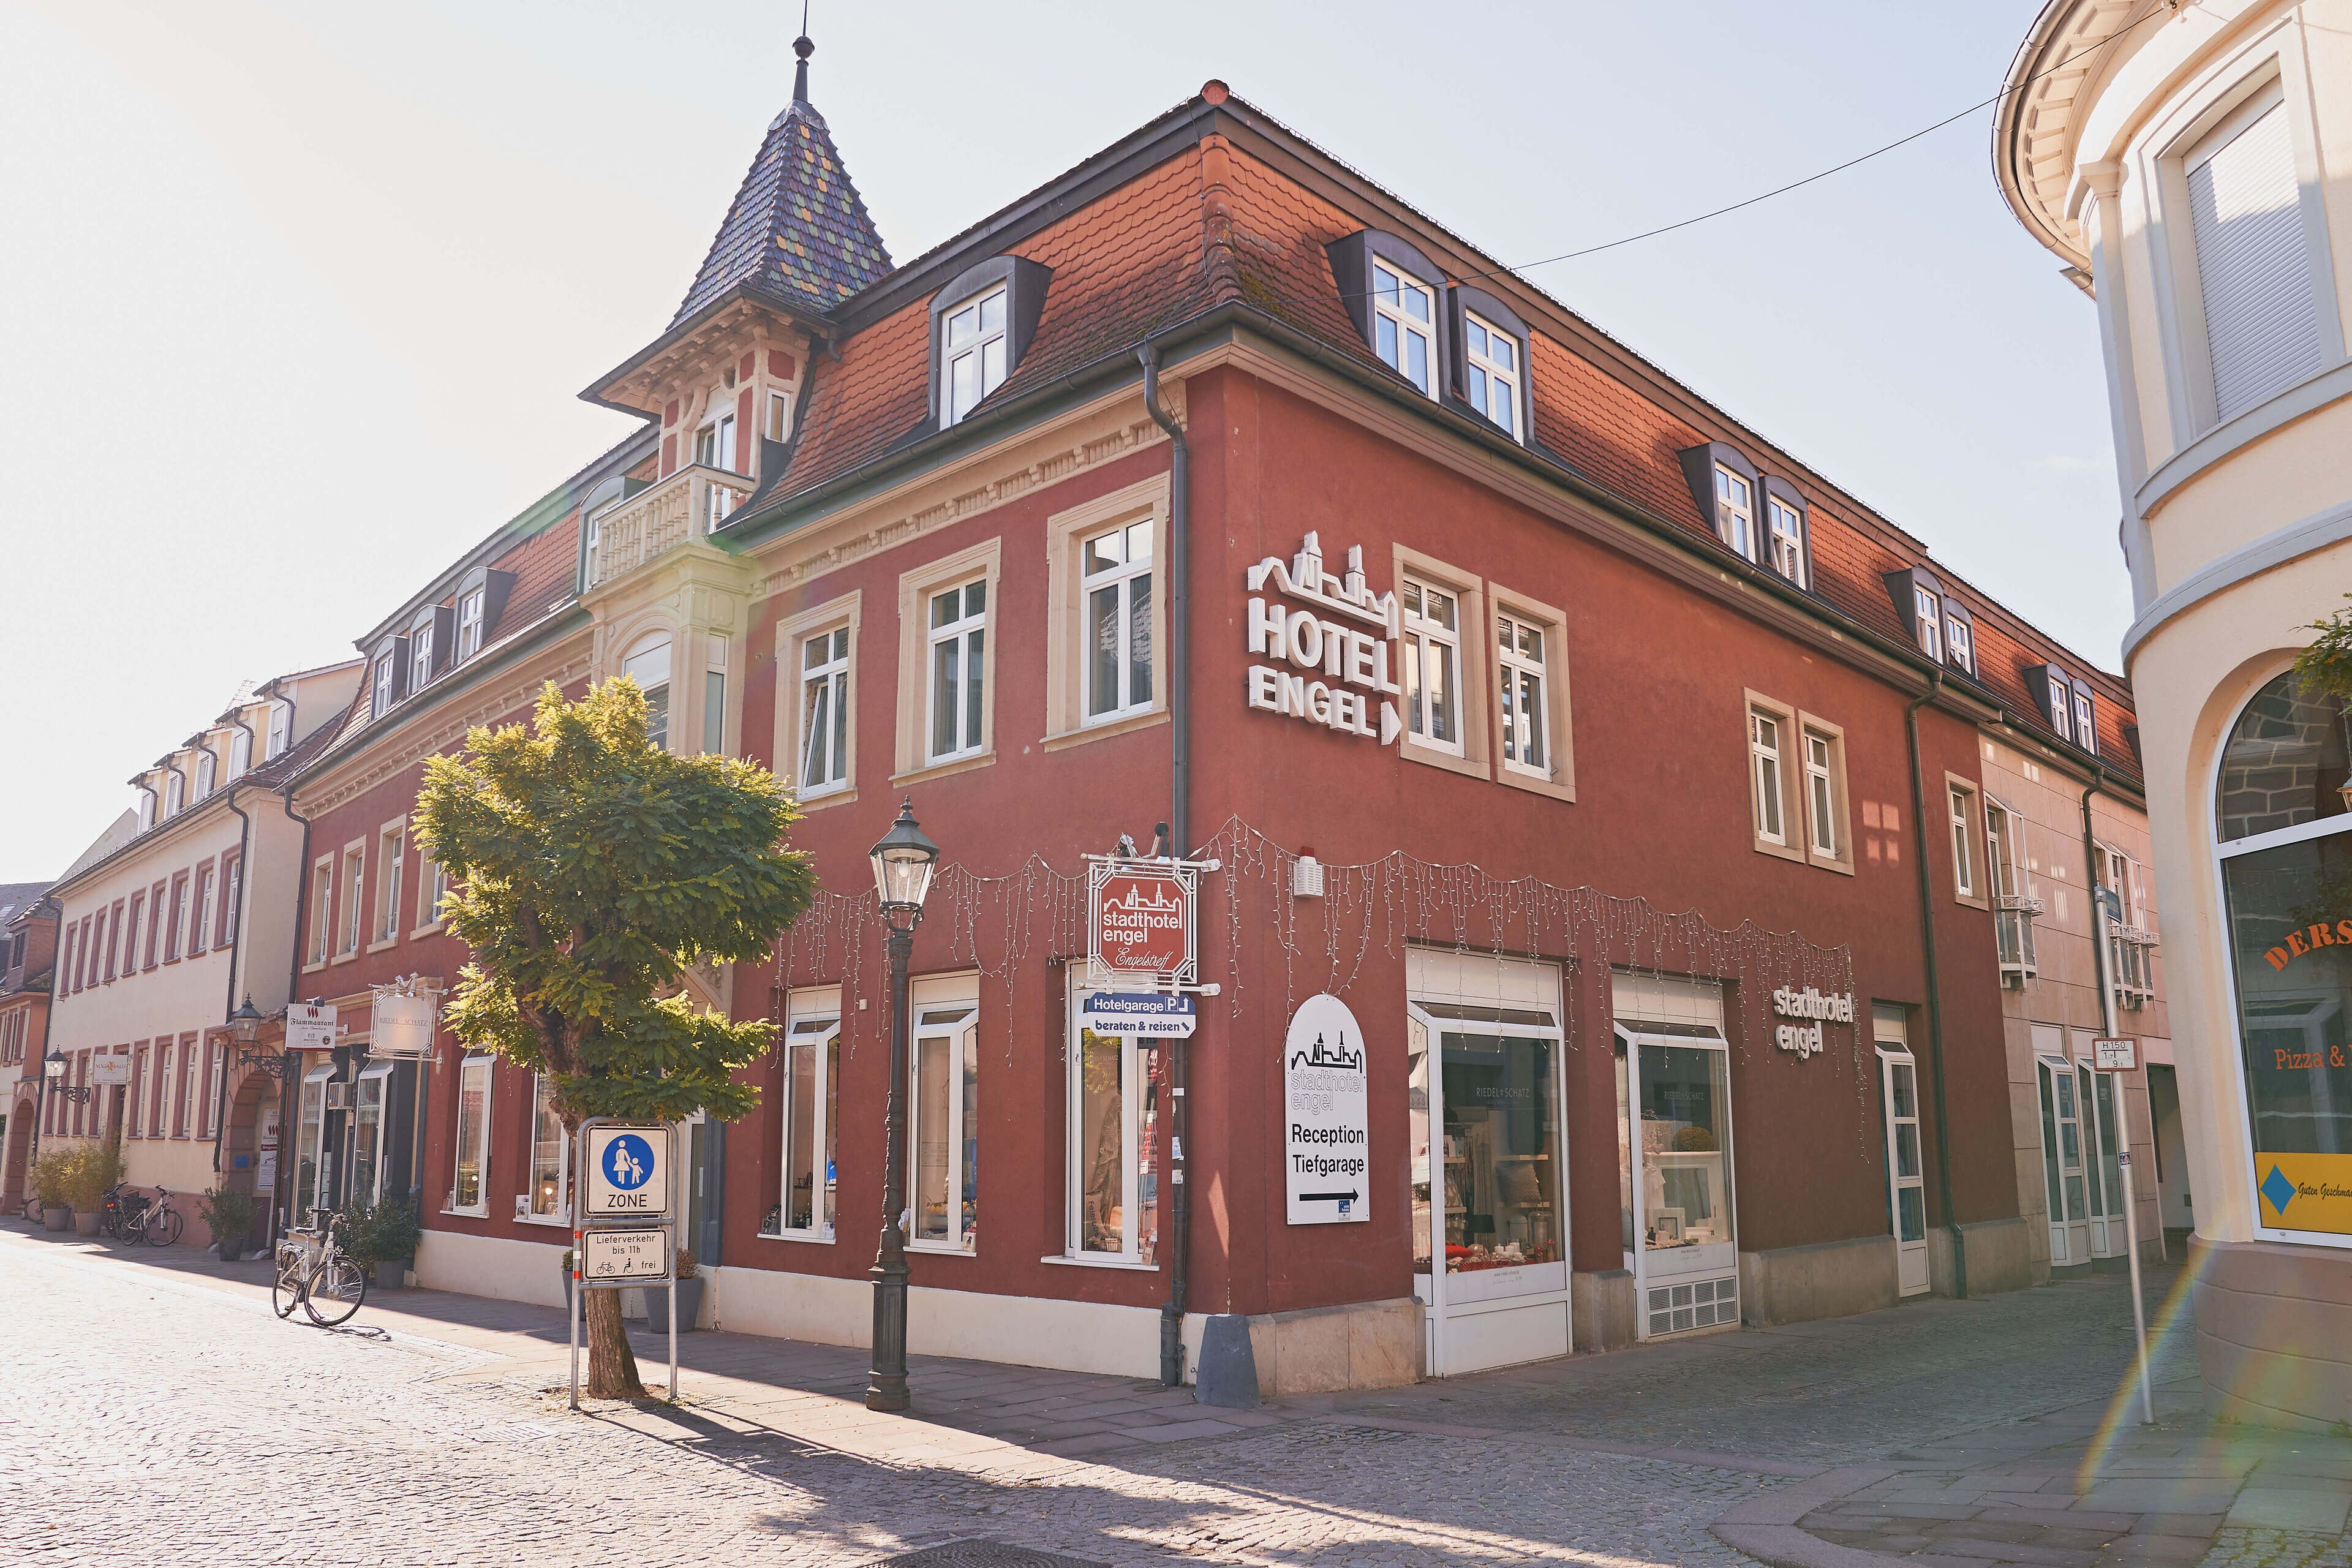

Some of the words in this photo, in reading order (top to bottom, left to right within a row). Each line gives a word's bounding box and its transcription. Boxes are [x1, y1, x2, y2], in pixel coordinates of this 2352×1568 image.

[1248, 597, 1401, 696] HOTEL
[1248, 665, 1377, 738] ENGEL
[1103, 911, 1182, 929] stadthotel
[1103, 928, 1148, 946] engel
[1115, 948, 1174, 971] Engelstreff
[1094, 998, 1164, 1013] Hotelgarage
[1773, 985, 1853, 1023] stadthotel
[1095, 1020, 1136, 1031] beraten
[1138, 1021, 1145, 1031] &
[1148, 1021, 1180, 1031] reisen
[1776, 1021, 1823, 1059] engel
[2274, 1048, 2326, 1070] Pizza
[2329, 1044, 2345, 1067] &
[1291, 1069, 1363, 1093] stadthotel
[1291, 1090, 1333, 1115] engel
[1476, 1087, 1500, 1097] RIEDEL
[1505, 1088, 1529, 1098] SCHATZ
[1292, 1123, 1364, 1147] Reception
[1292, 1154, 1365, 1177] Tiefgarage
[2298, 1182, 2318, 1199] Guten
[608, 1194, 647, 1208] ZONE
[597, 1234, 655, 1244] Lieferverkehr
[629, 1245, 641, 1254] 11h
[641, 1261, 656, 1269] frei
